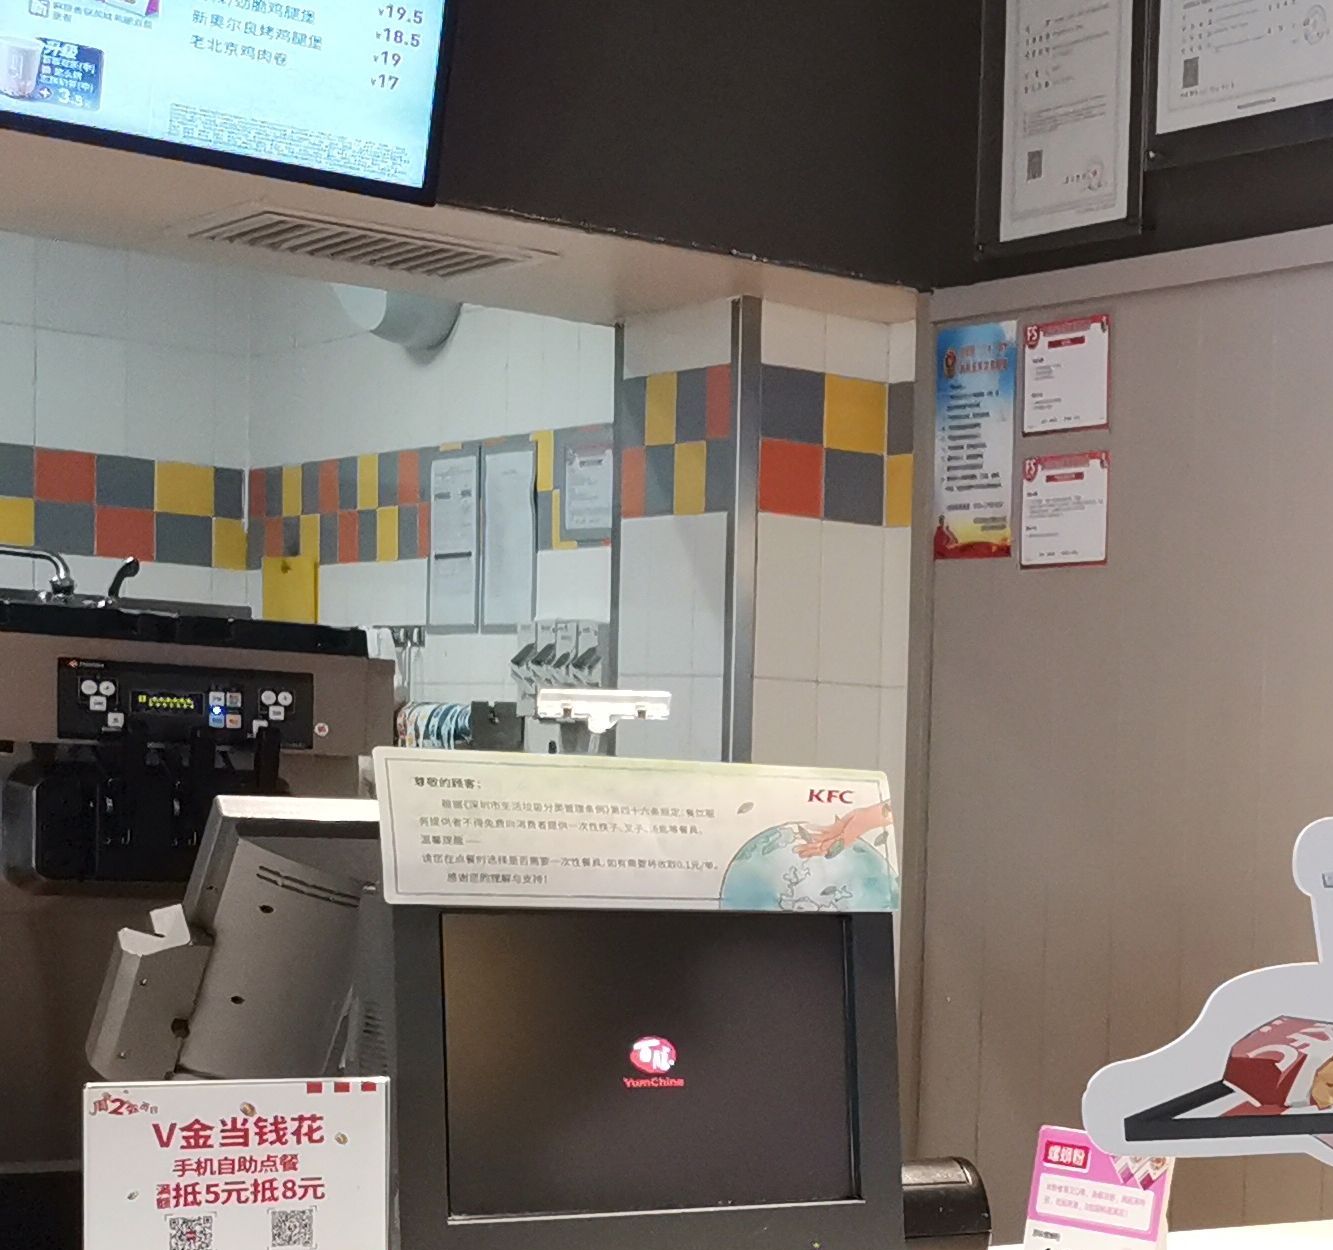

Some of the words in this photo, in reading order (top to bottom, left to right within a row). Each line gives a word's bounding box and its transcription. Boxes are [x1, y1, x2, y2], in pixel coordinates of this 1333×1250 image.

[192, 9, 323, 51] 新奥尔良烤鸡腿堡
[190, 34, 288, 67] 老北京鸡肉卷
[808, 788, 855, 804] KFC
[152, 1113, 325, 1150] V金当钱花
[172, 1153, 299, 1178] 手机自助点餐
